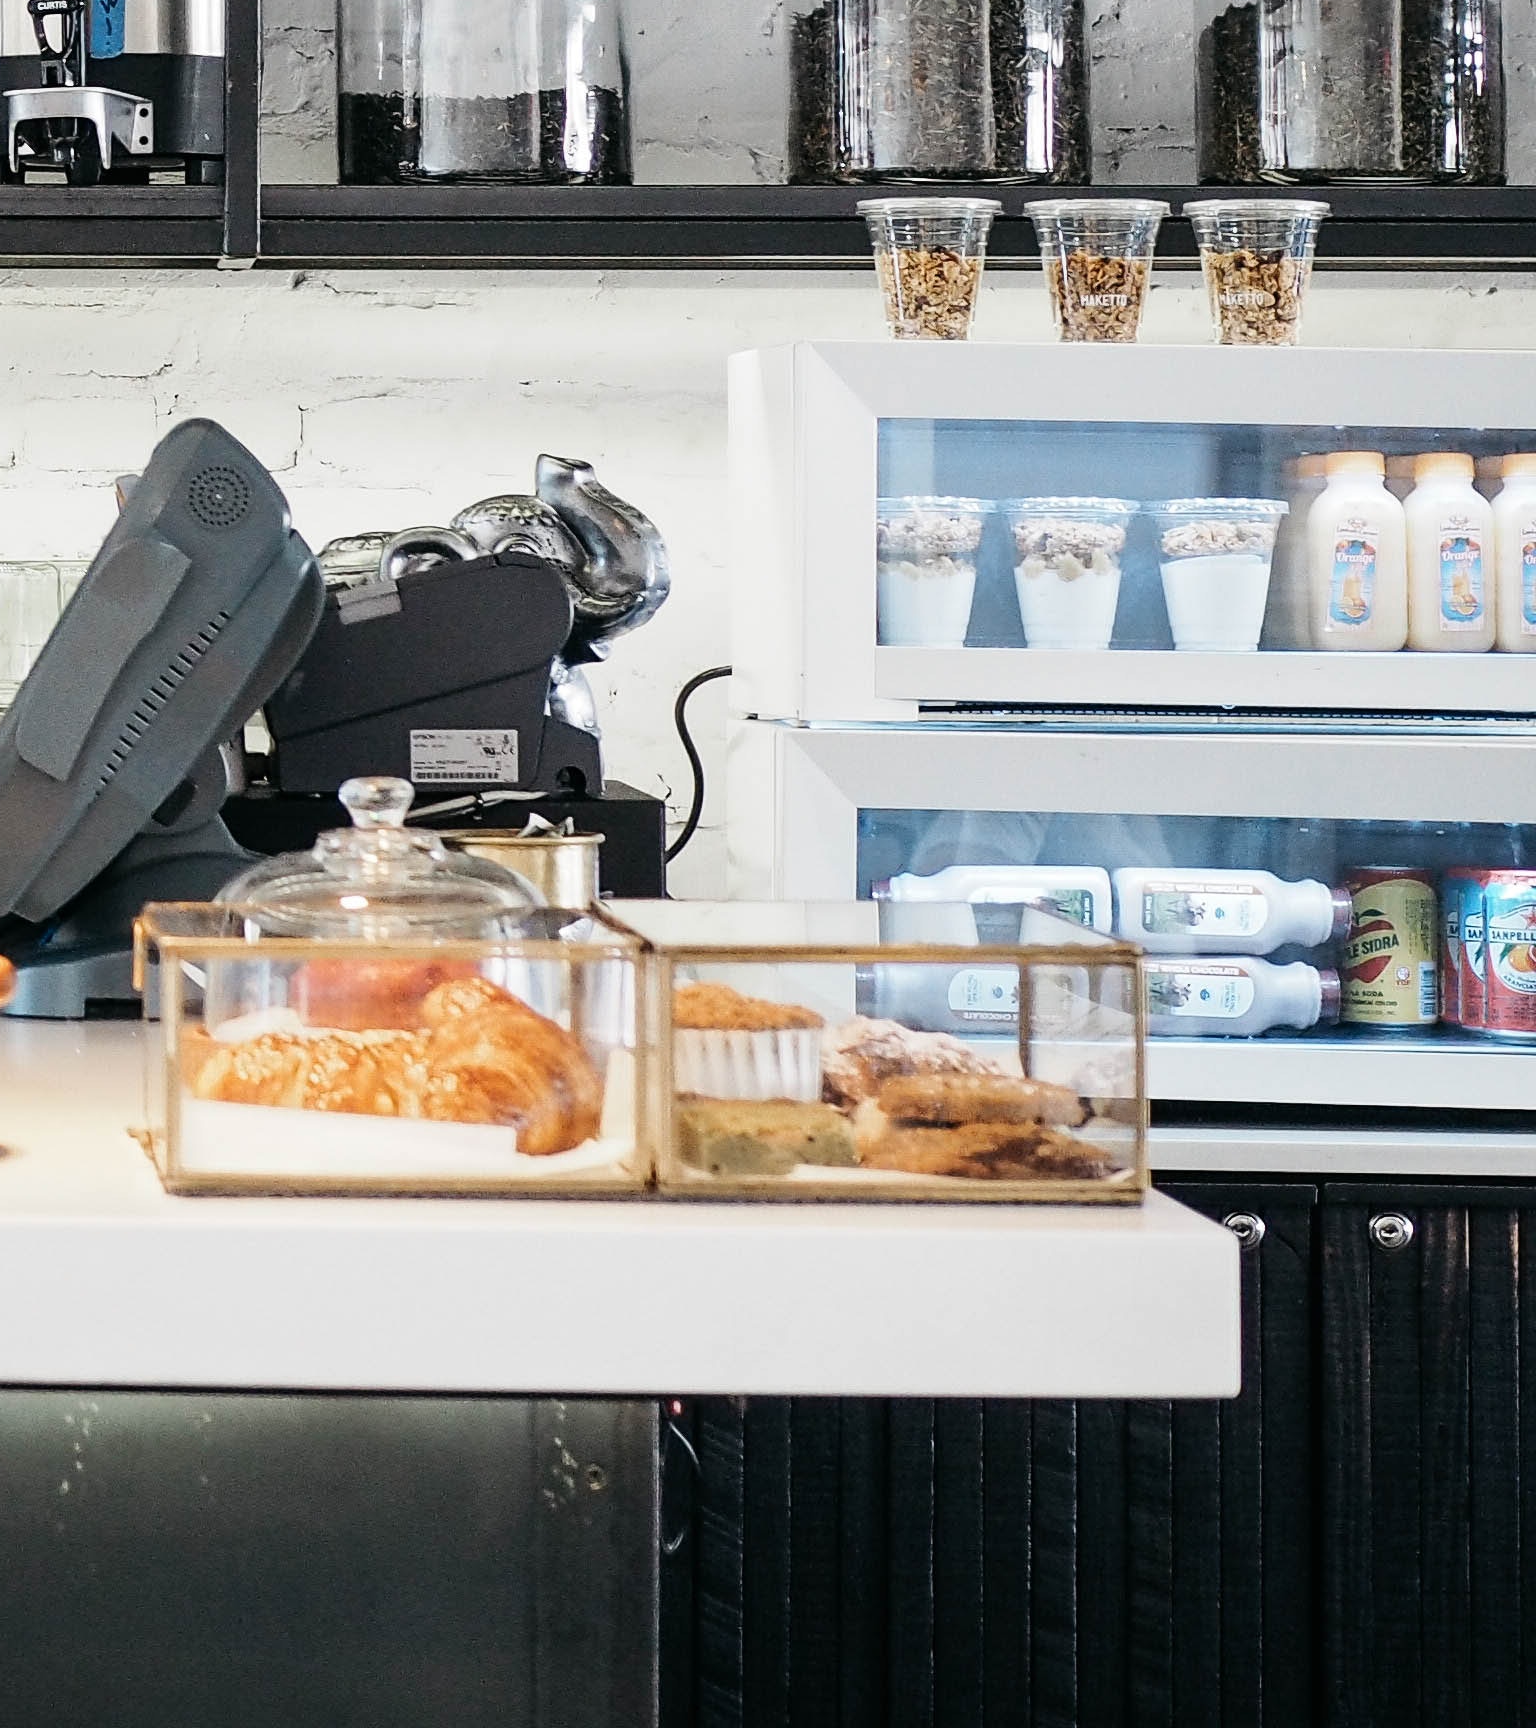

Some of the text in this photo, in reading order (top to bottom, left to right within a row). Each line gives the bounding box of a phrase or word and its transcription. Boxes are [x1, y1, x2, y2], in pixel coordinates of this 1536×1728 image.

[37, 0, 68, 11] CURTIS
[1079, 293, 1128, 307] MAKETTO
[1219, 290, 1264, 306] MAKETTO
[1362, 933, 1400, 954] SIDRA
